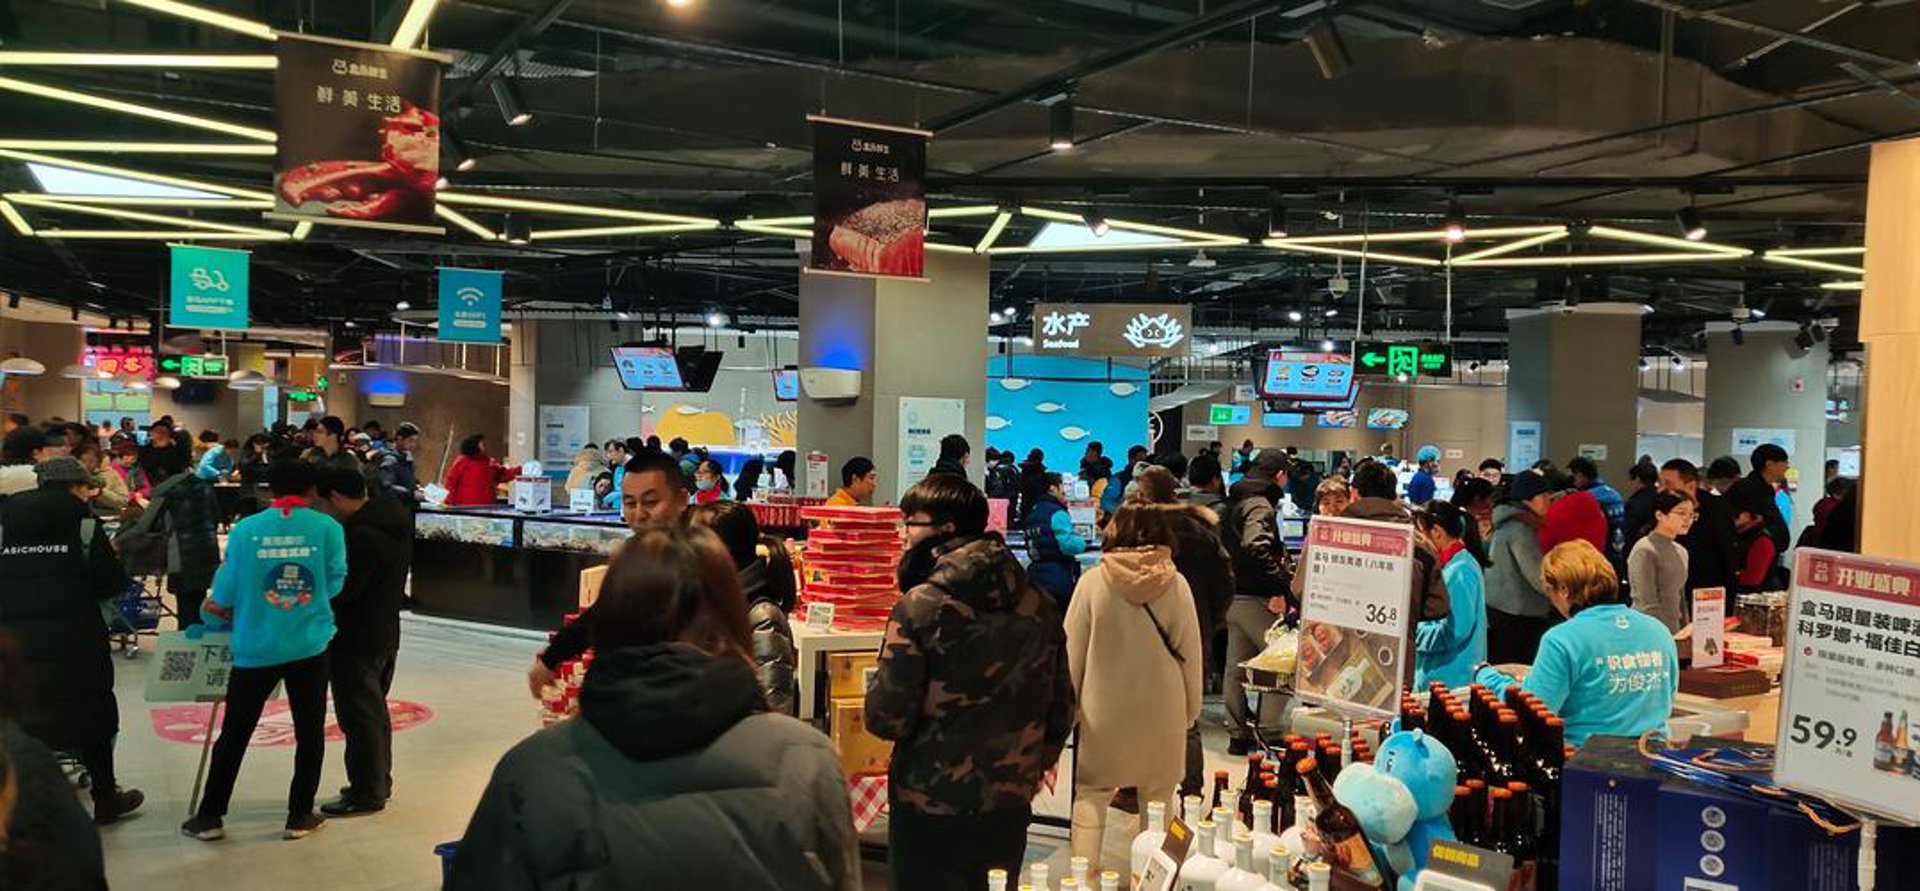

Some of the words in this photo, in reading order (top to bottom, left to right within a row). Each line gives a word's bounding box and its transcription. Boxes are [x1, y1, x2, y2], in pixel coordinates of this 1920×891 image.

[316, 85, 401, 113] 鲜美生活
[1042, 311, 1090, 336] 水产
[1042, 338, 1080, 349] Seafood
[1837, 566, 1911, 597] 开业盛典
[1365, 603, 1397, 625] 36.8
[1790, 714, 1857, 750] 59.9
